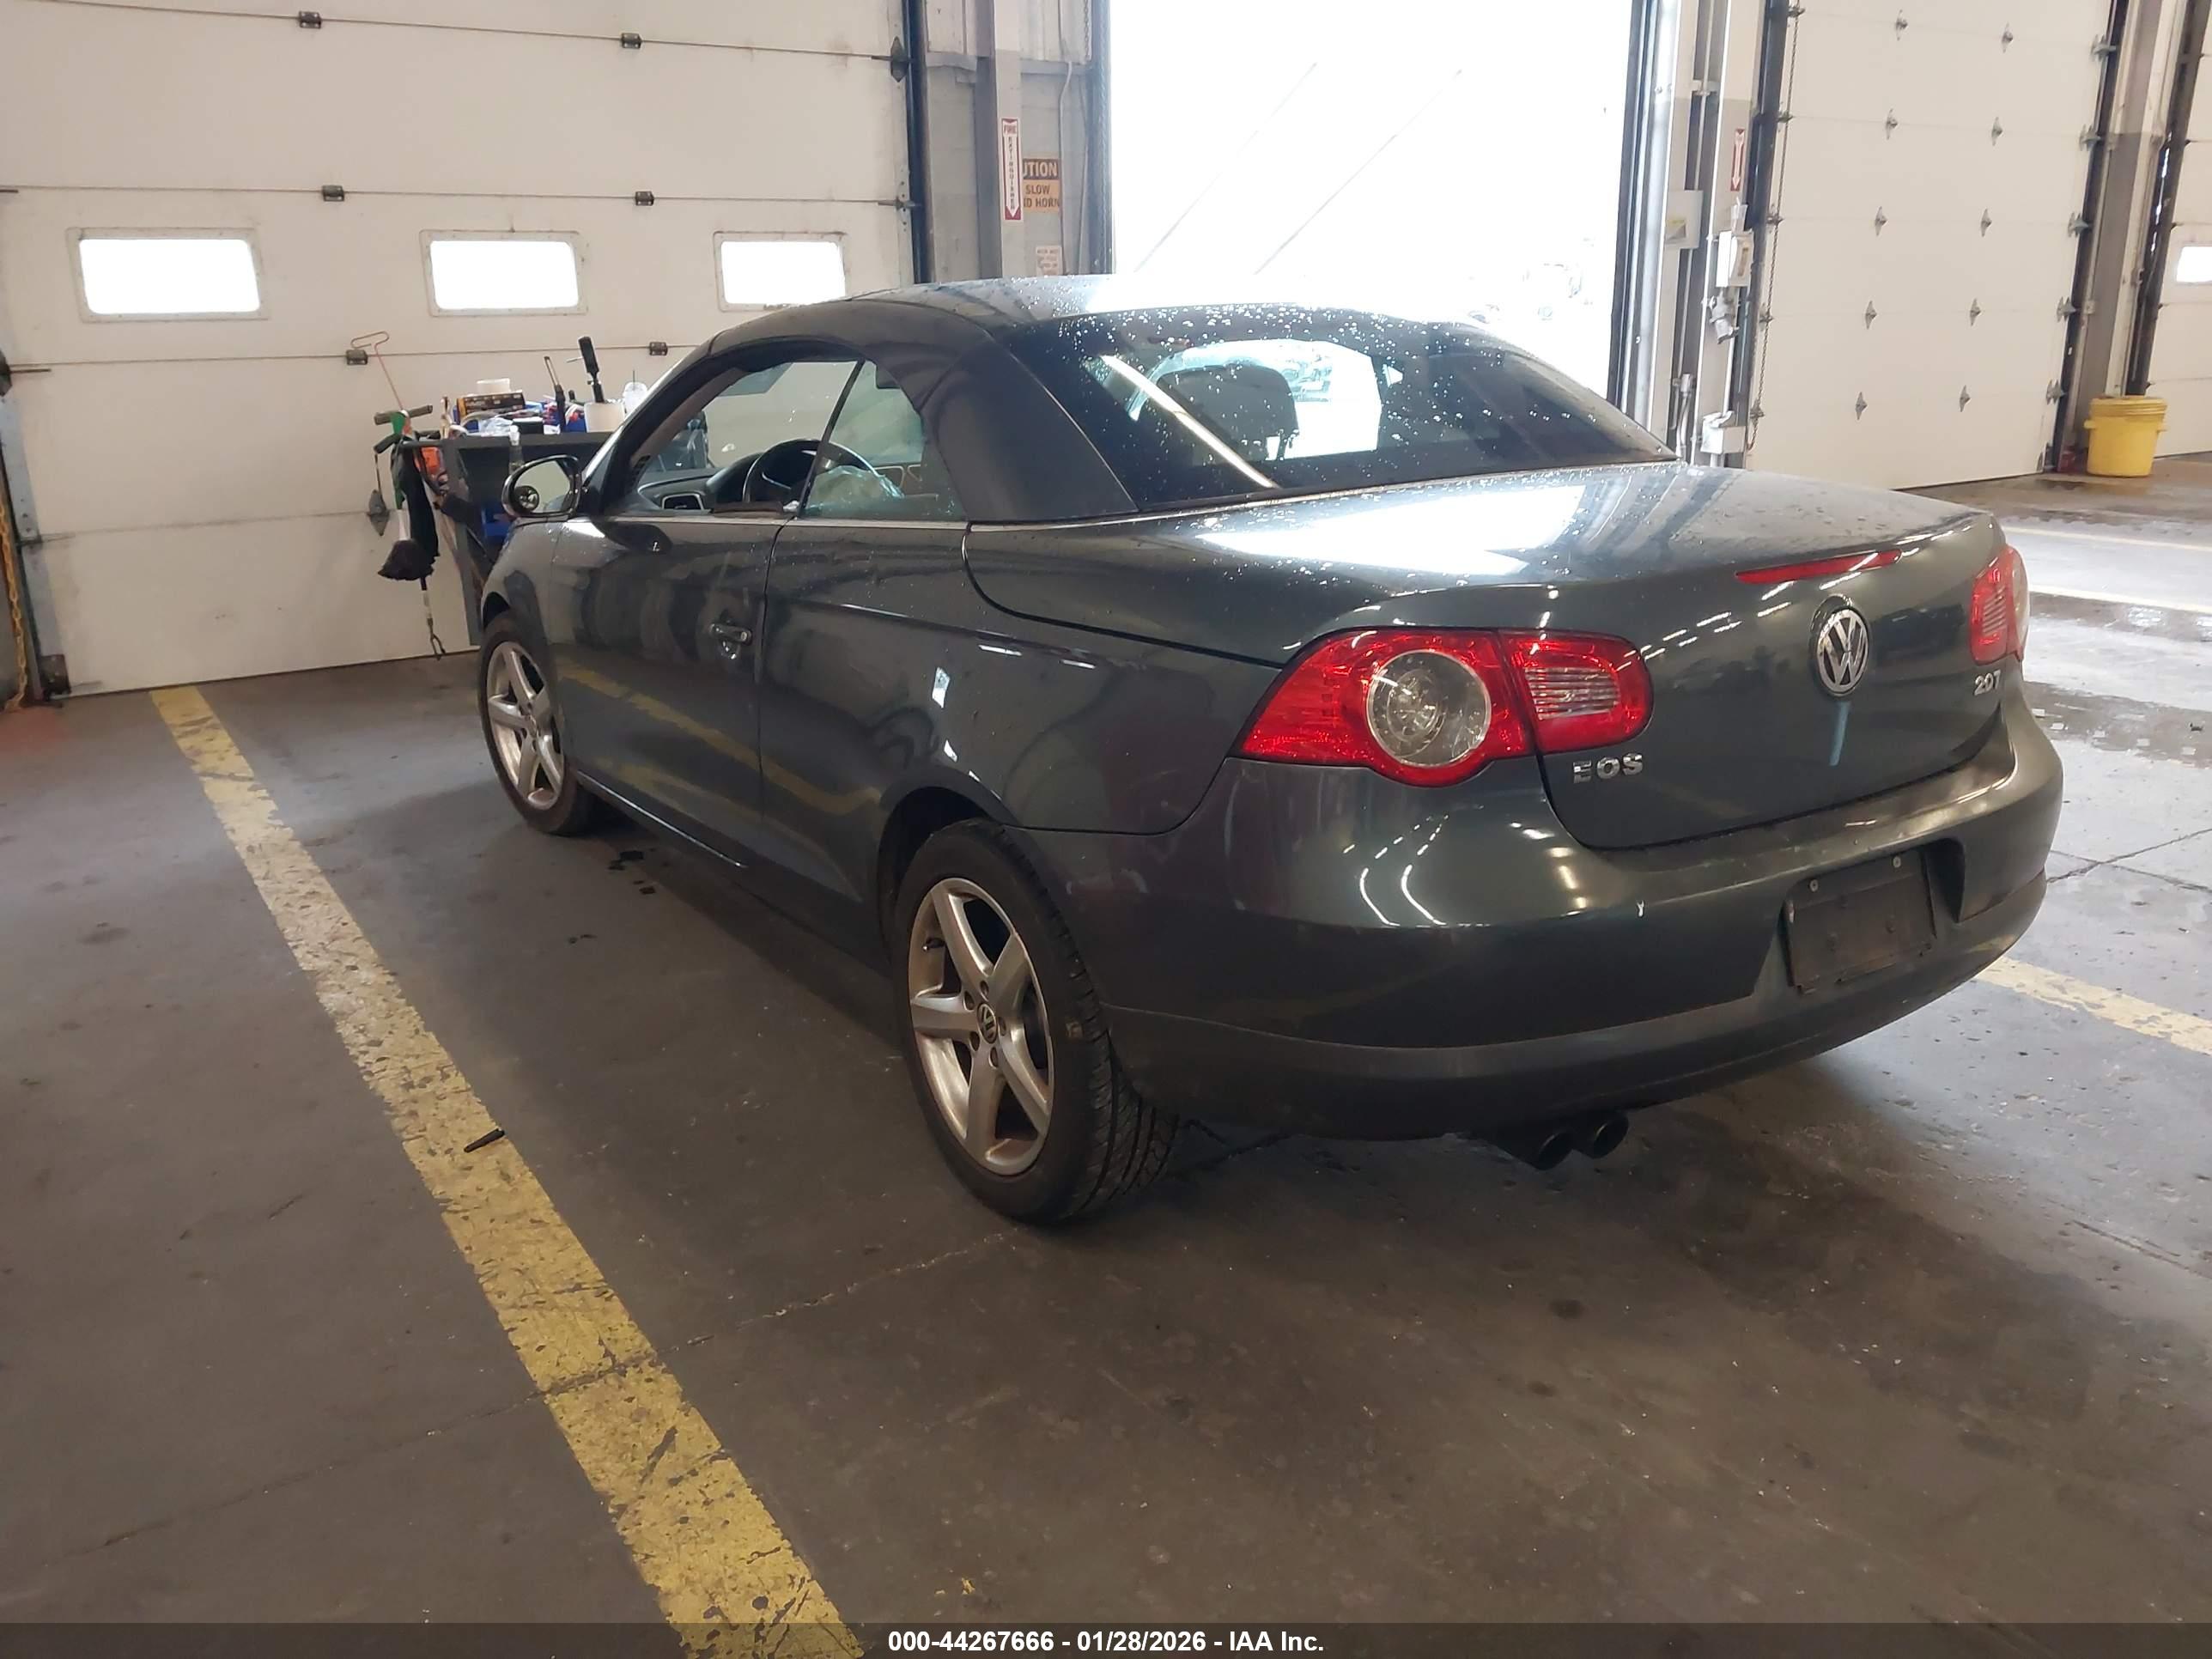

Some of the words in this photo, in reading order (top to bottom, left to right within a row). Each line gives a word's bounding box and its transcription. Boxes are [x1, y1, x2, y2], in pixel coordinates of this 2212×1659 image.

[1023, 161, 1057, 177] UTION
[1025, 185, 1050, 195] SLOW
[1572, 752, 1644, 783] EOS
